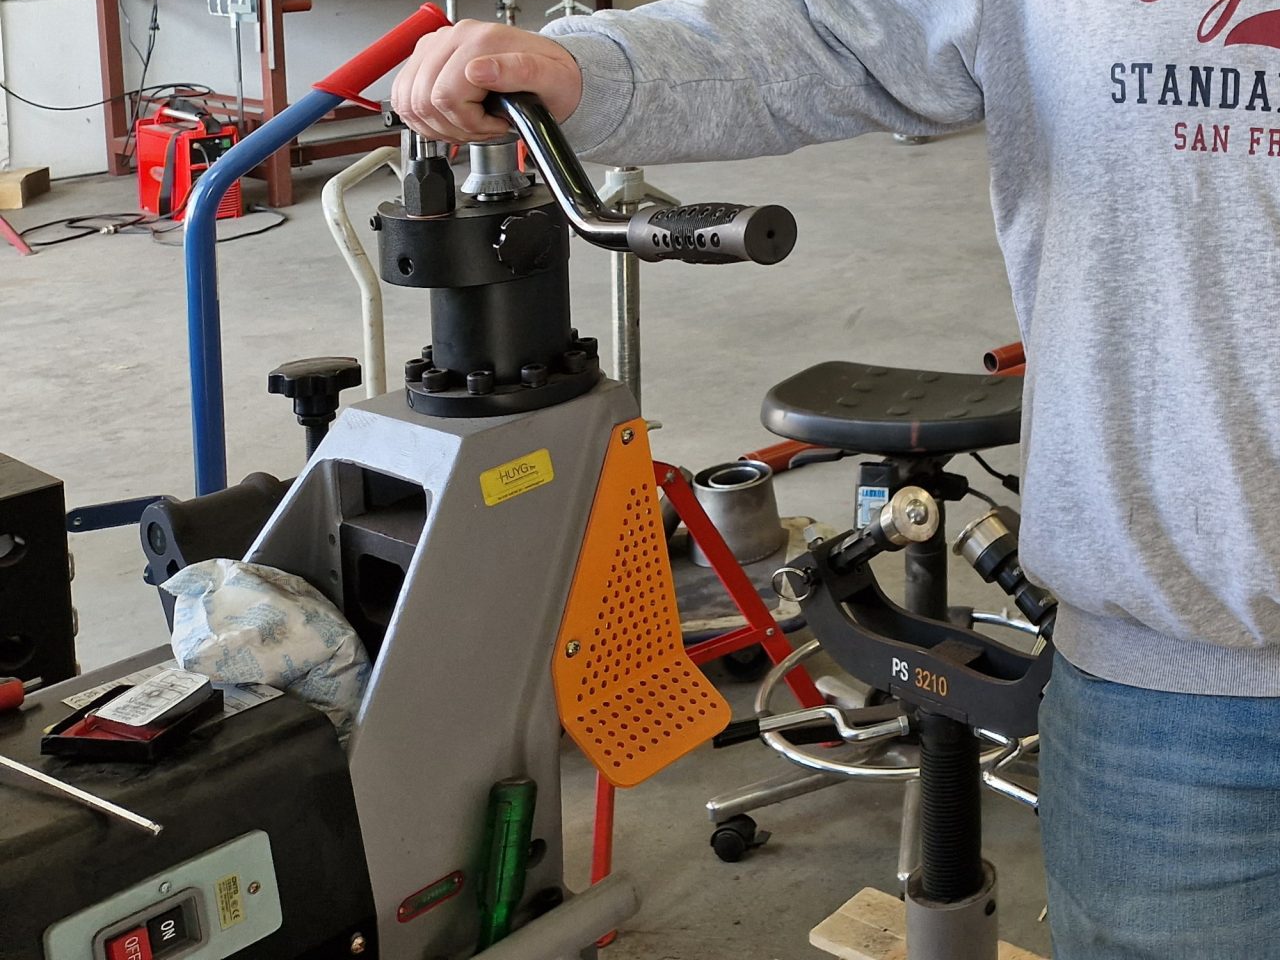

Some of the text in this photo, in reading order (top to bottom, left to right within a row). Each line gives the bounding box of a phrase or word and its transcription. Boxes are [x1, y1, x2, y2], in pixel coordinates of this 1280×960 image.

[1174, 122, 1230, 154] SAN
[499, 462, 528, 484] HUYG
[892, 657, 947, 697] PS 3210
[161, 920, 176, 941] ON
[125, 936, 142, 960] OFF
